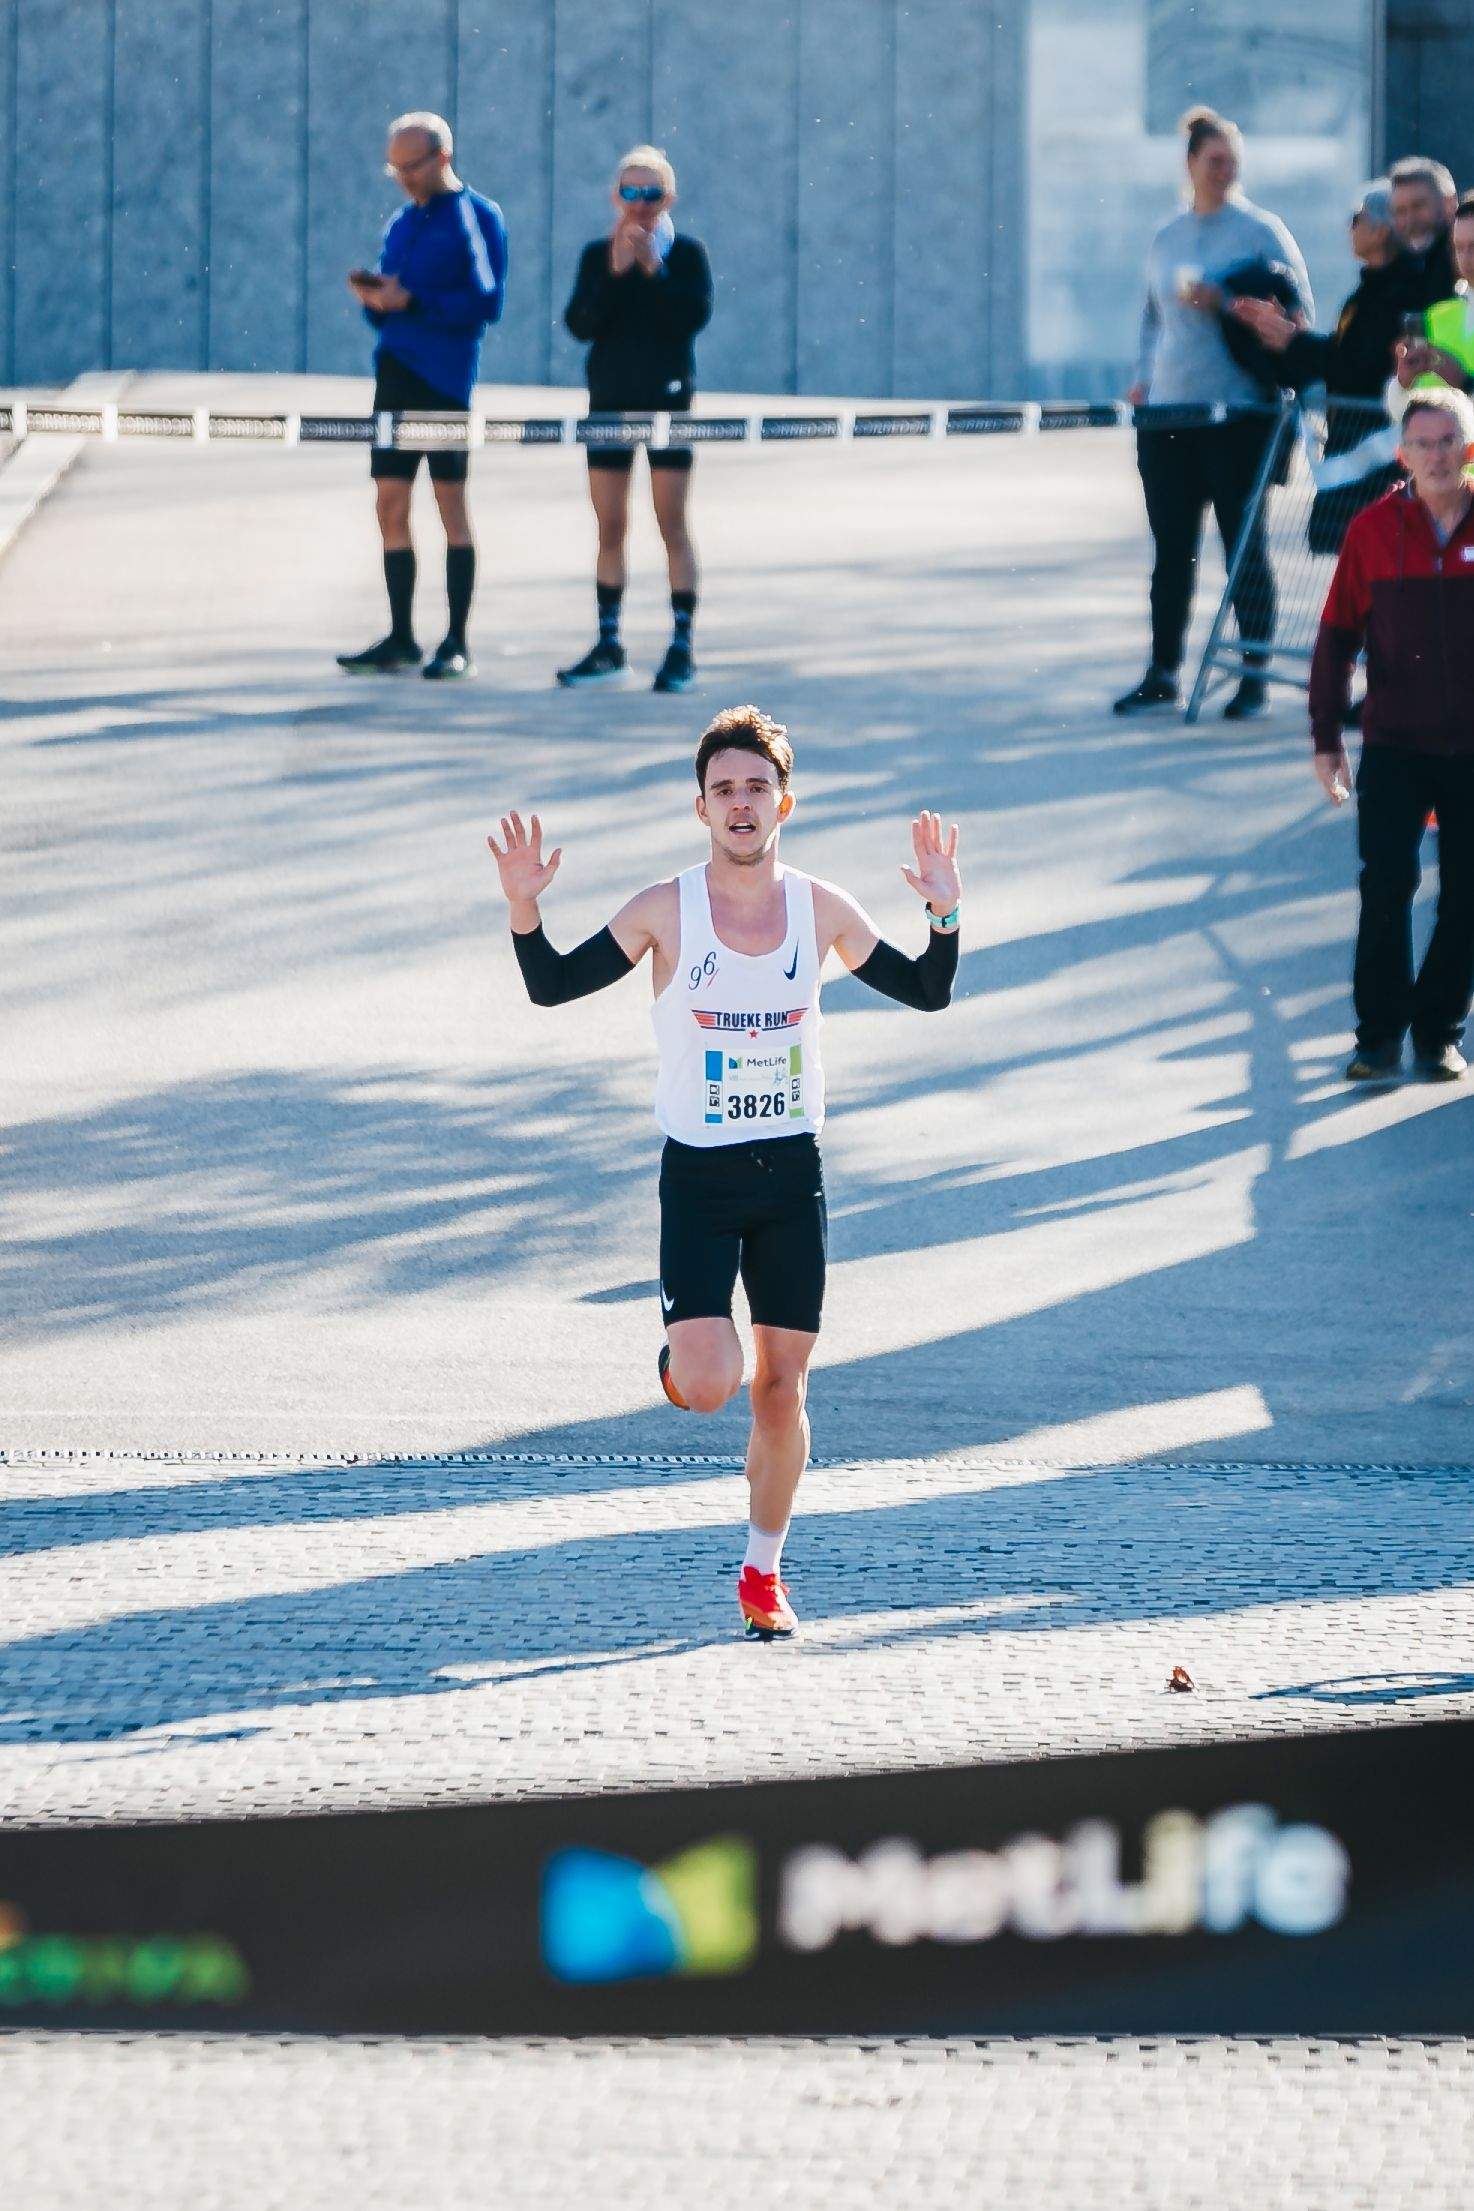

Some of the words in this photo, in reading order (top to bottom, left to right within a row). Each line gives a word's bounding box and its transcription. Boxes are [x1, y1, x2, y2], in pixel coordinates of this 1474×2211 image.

[715, 1010, 762, 1028] TRUEKE
[764, 1010, 789, 1026] RUN
[746, 1055, 787, 1069] MetLife
[727, 1091, 786, 1120] 3826
